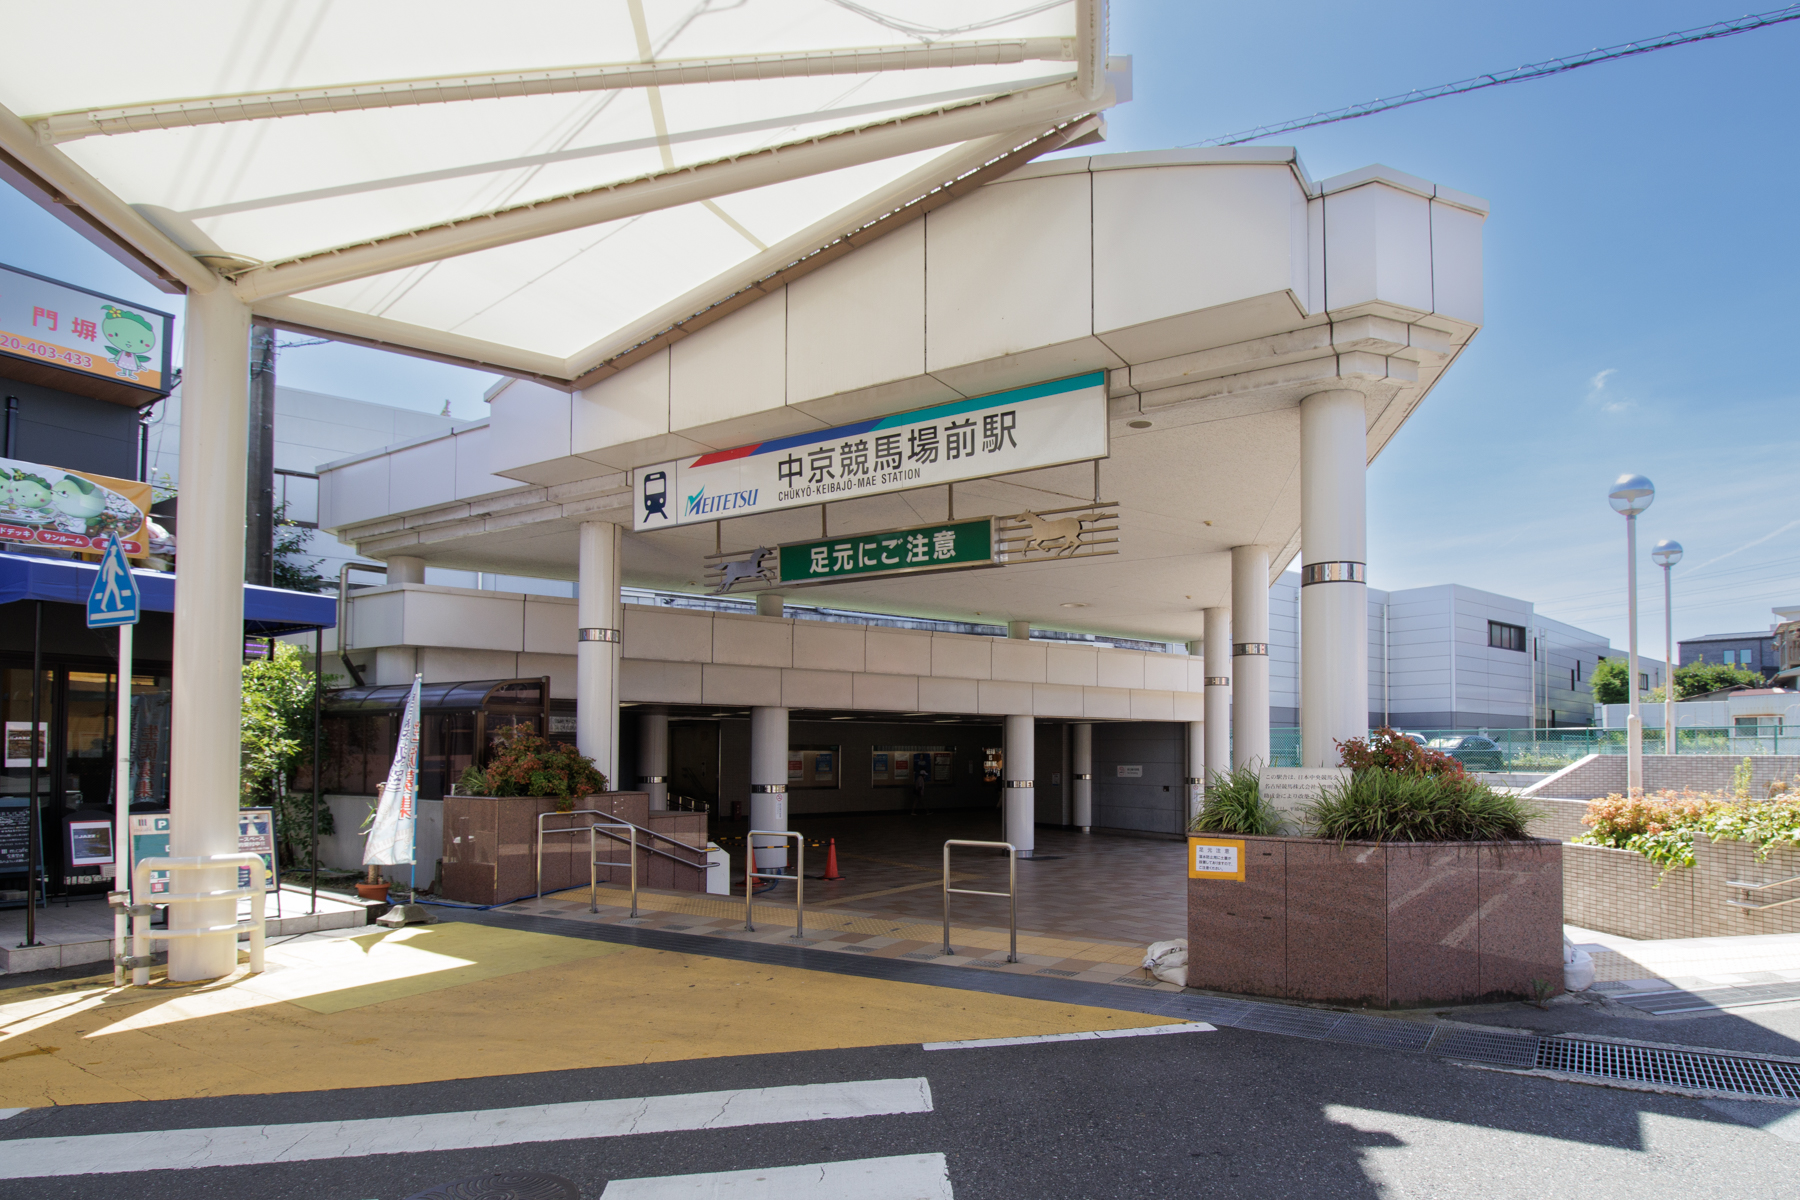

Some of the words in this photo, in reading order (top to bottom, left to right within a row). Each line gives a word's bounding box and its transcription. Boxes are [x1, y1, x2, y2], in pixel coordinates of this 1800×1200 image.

[32, 305, 98, 342] 門塀
[0, 334, 93, 368] 20-403-433
[777, 410, 1018, 488] 中京競馬場前駅
[684, 485, 758, 517] MEITETSU
[778, 475, 877, 502] CHŪKYŌ-KEIBAJŌ-MAE
[881, 467, 921, 485] STATION
[43, 533, 83, 545] サンルーム
[809, 529, 957, 574] 足元にご注意
[1198, 847, 1230, 855] 足元注意
